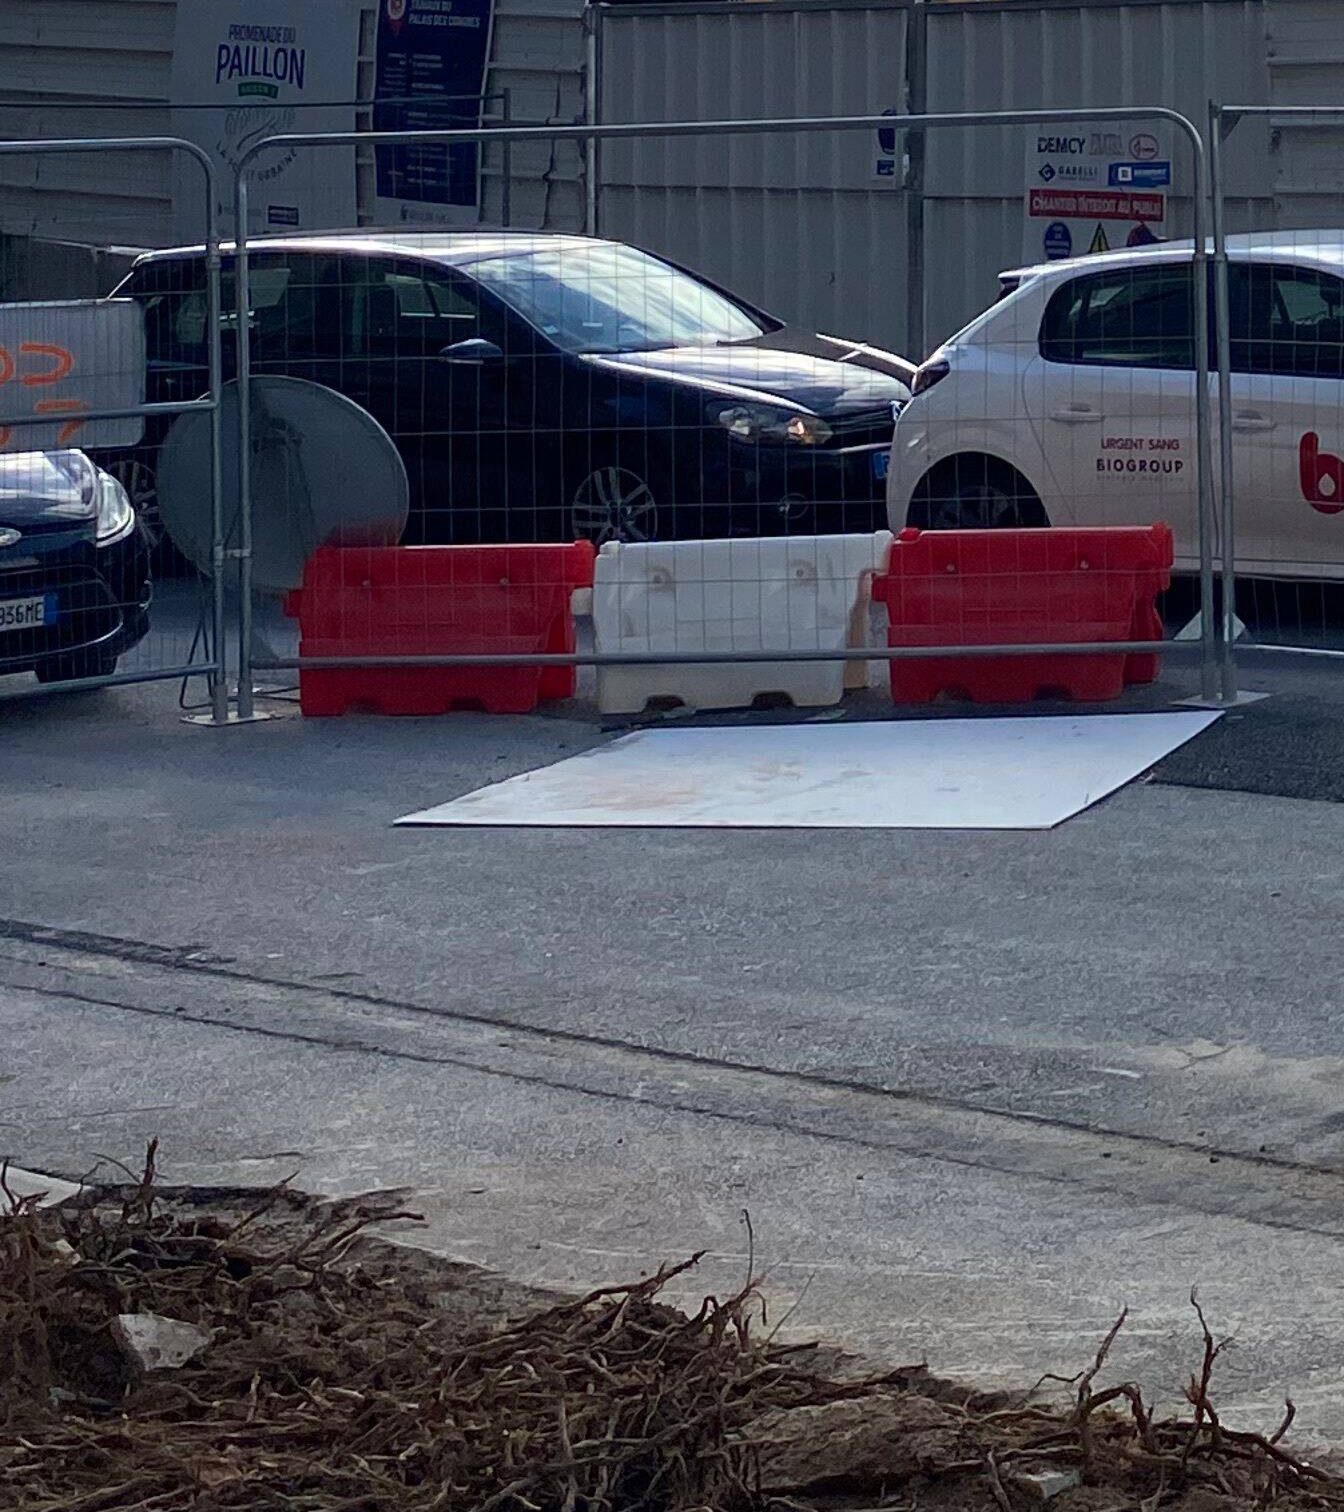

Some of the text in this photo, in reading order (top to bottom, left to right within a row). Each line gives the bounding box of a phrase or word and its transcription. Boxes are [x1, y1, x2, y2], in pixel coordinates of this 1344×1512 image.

[409, 13, 433, 25] PALAIS
[434, 14, 448, 25] DES
[229, 24, 296, 44] PROMENADE DU
[216, 44, 306, 90] PAILLON
[1037, 136, 1086, 154] DEMCY
[1101, 438, 1180, 450] URGENT SANG
[1096, 458, 1184, 473] BIOGROUP
